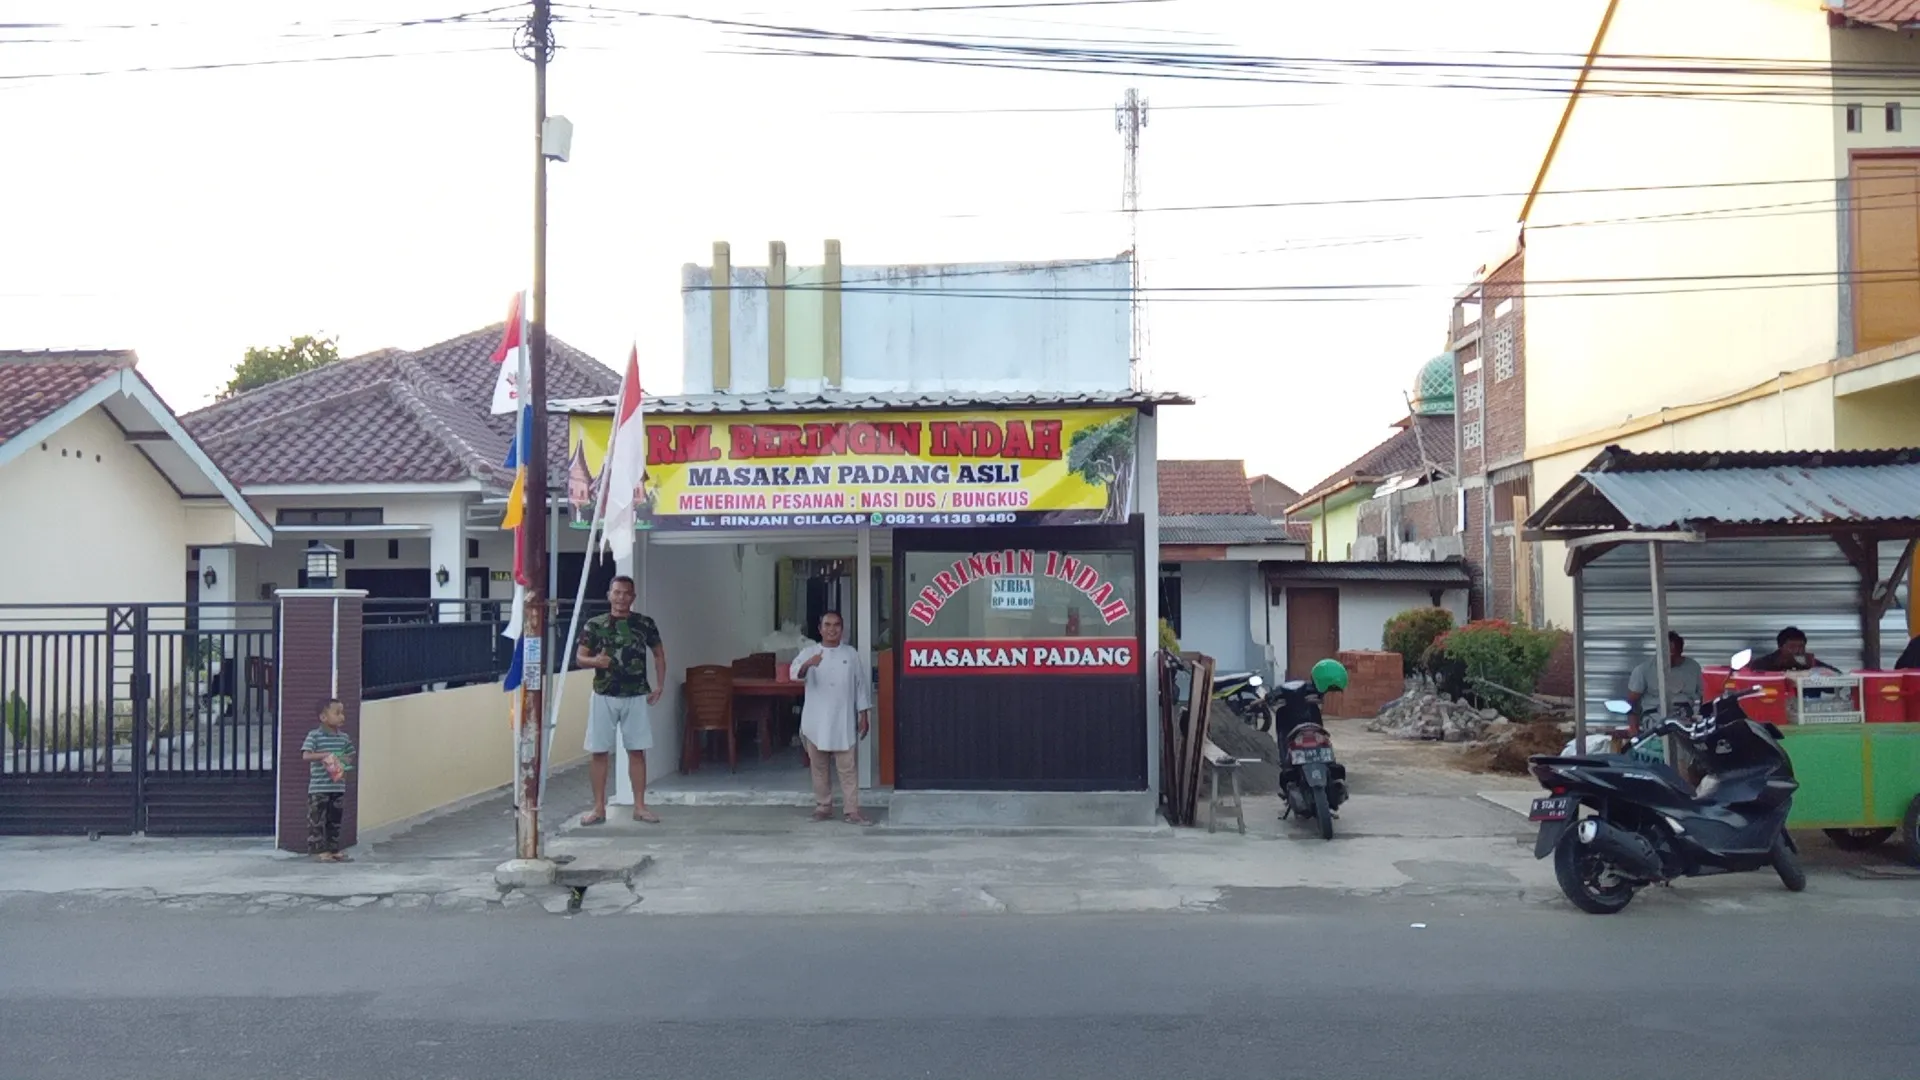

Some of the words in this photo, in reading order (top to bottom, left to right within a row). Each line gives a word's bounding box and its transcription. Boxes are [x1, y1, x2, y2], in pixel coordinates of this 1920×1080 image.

[646, 424, 721, 465] RM.
[728, 420, 922, 460] BERINGIN
[929, 420, 1063, 460] INDAH
[688, 465, 831, 486] MASAKAN
[837, 464, 950, 485] PADANG
[956, 463, 1020, 483] ASLI
[679, 493, 767, 511] MENERIMA
[772, 493, 844, 510] PESANAN
[861, 492, 898, 508] NASI
[904, 491, 936, 508] DUS
[952, 490, 1028, 508] BUNGKUS
[691, 516, 715, 527] JL.
[720, 515, 791, 527] RINJANI
[794, 514, 866, 526] CILACAP
[885, 513, 924, 525] 0821
[930, 513, 972, 524] 4138
[908, 549, 1035, 626] BERINGIN
[1044, 550, 1131, 625] INDAH
[994, 579, 1032, 593] SERBA
[909, 648, 1028, 668] MASAKAN
[1032, 647, 1132, 667] PADANG
